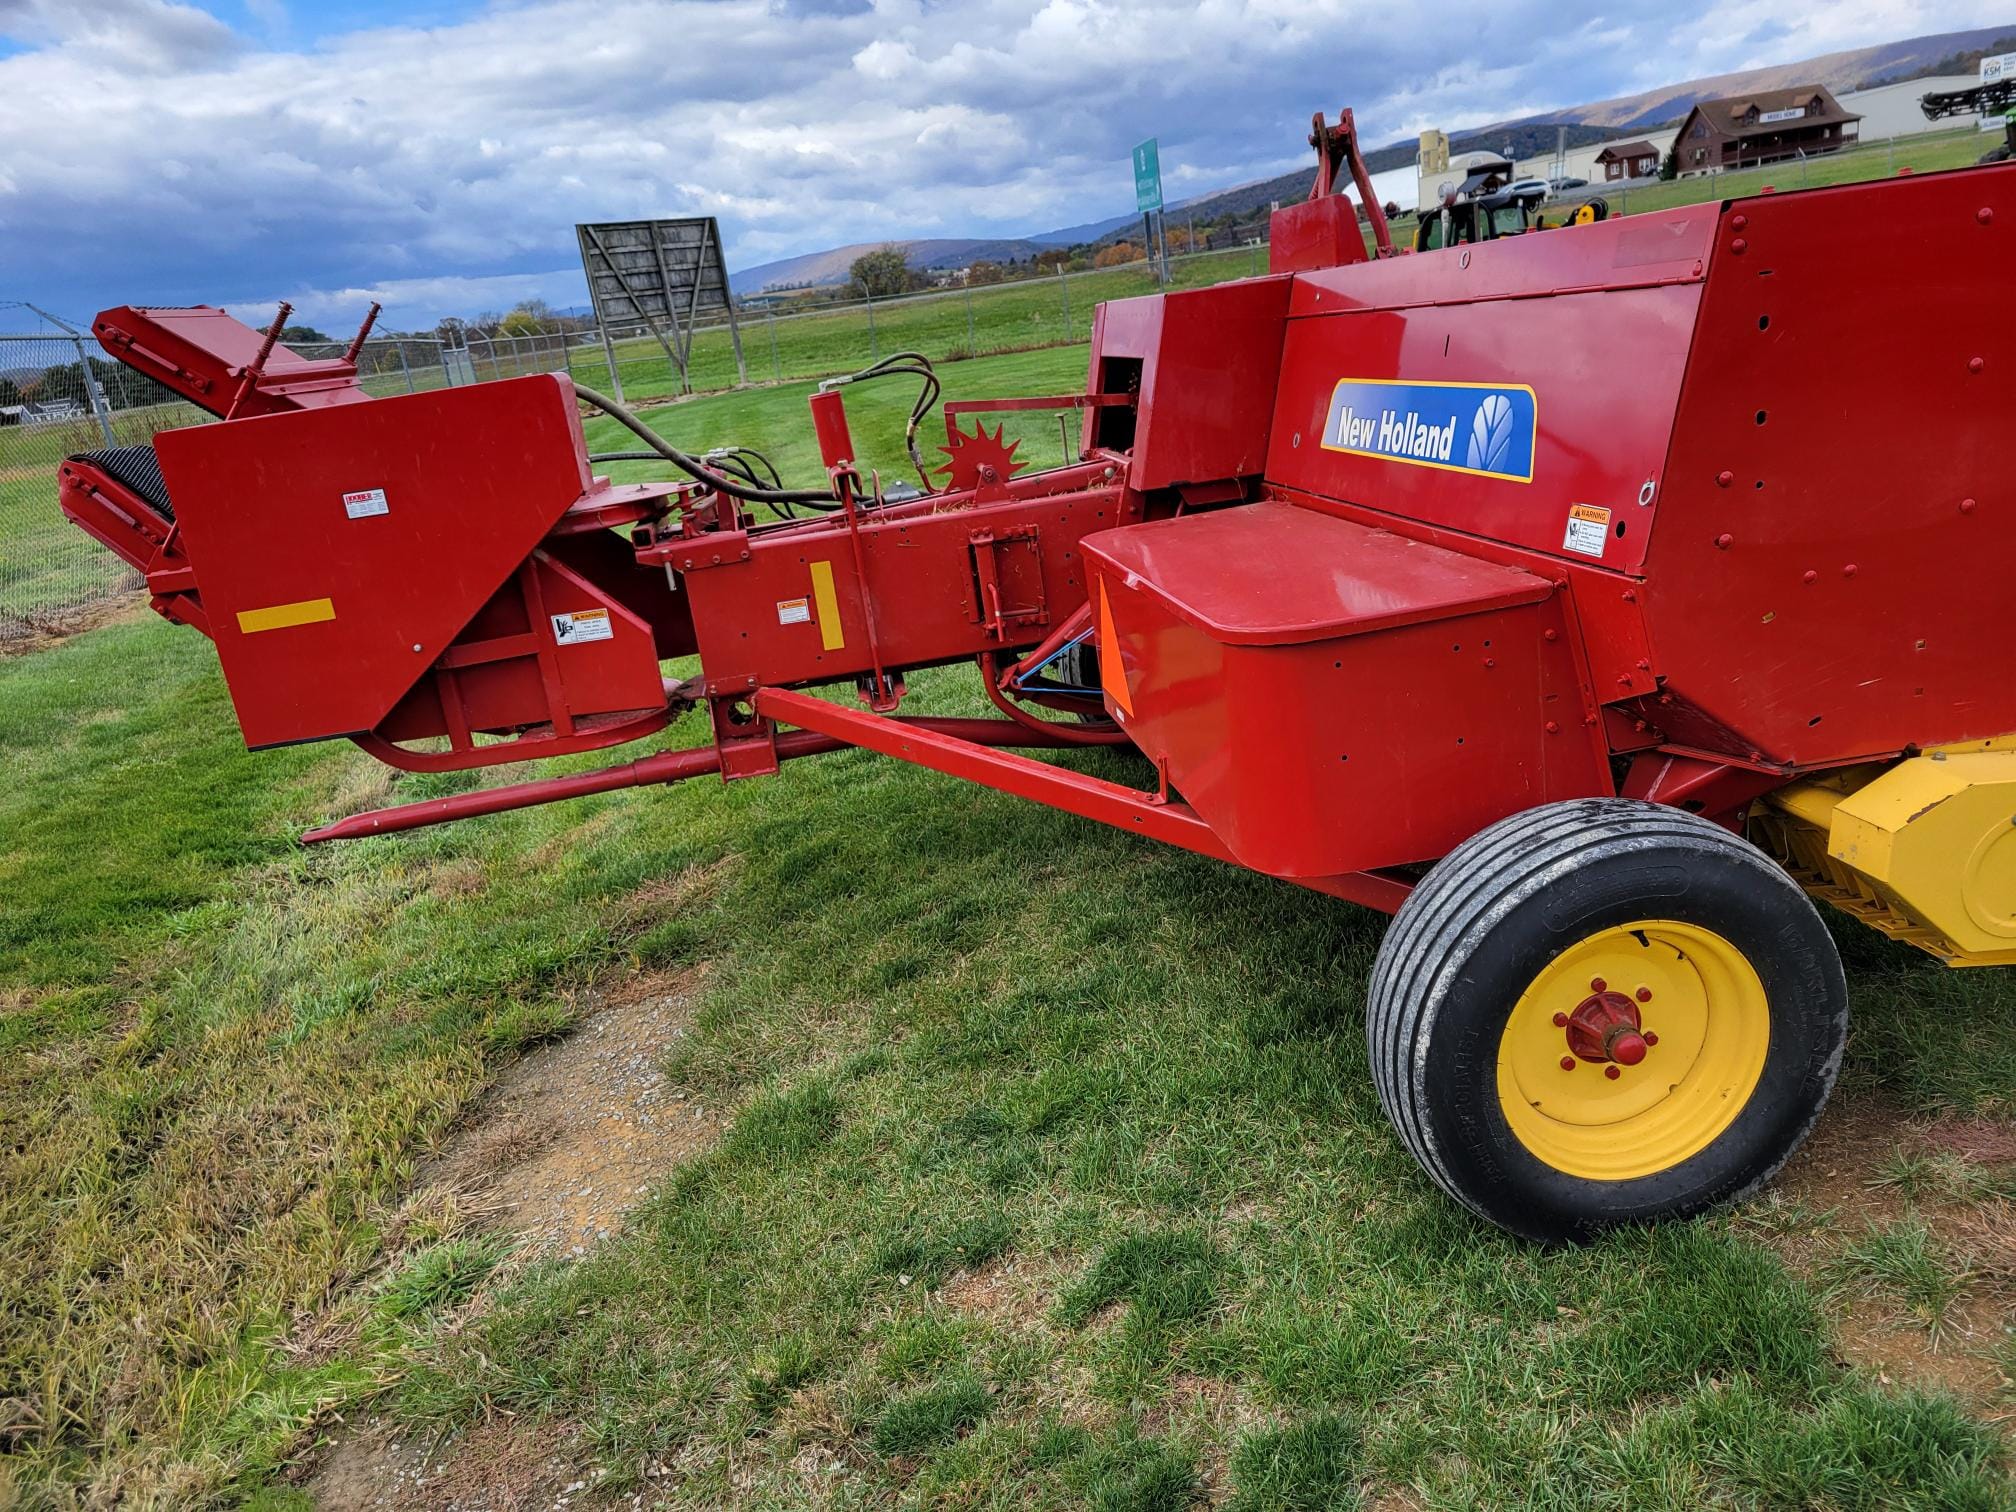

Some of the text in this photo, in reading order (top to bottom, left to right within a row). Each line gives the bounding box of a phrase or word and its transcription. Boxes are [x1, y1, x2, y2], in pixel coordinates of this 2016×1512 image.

[1984, 64, 2001, 77] KSM
[1337, 406, 1457, 461] New Holland
[1581, 508, 1606, 521] WARNING
